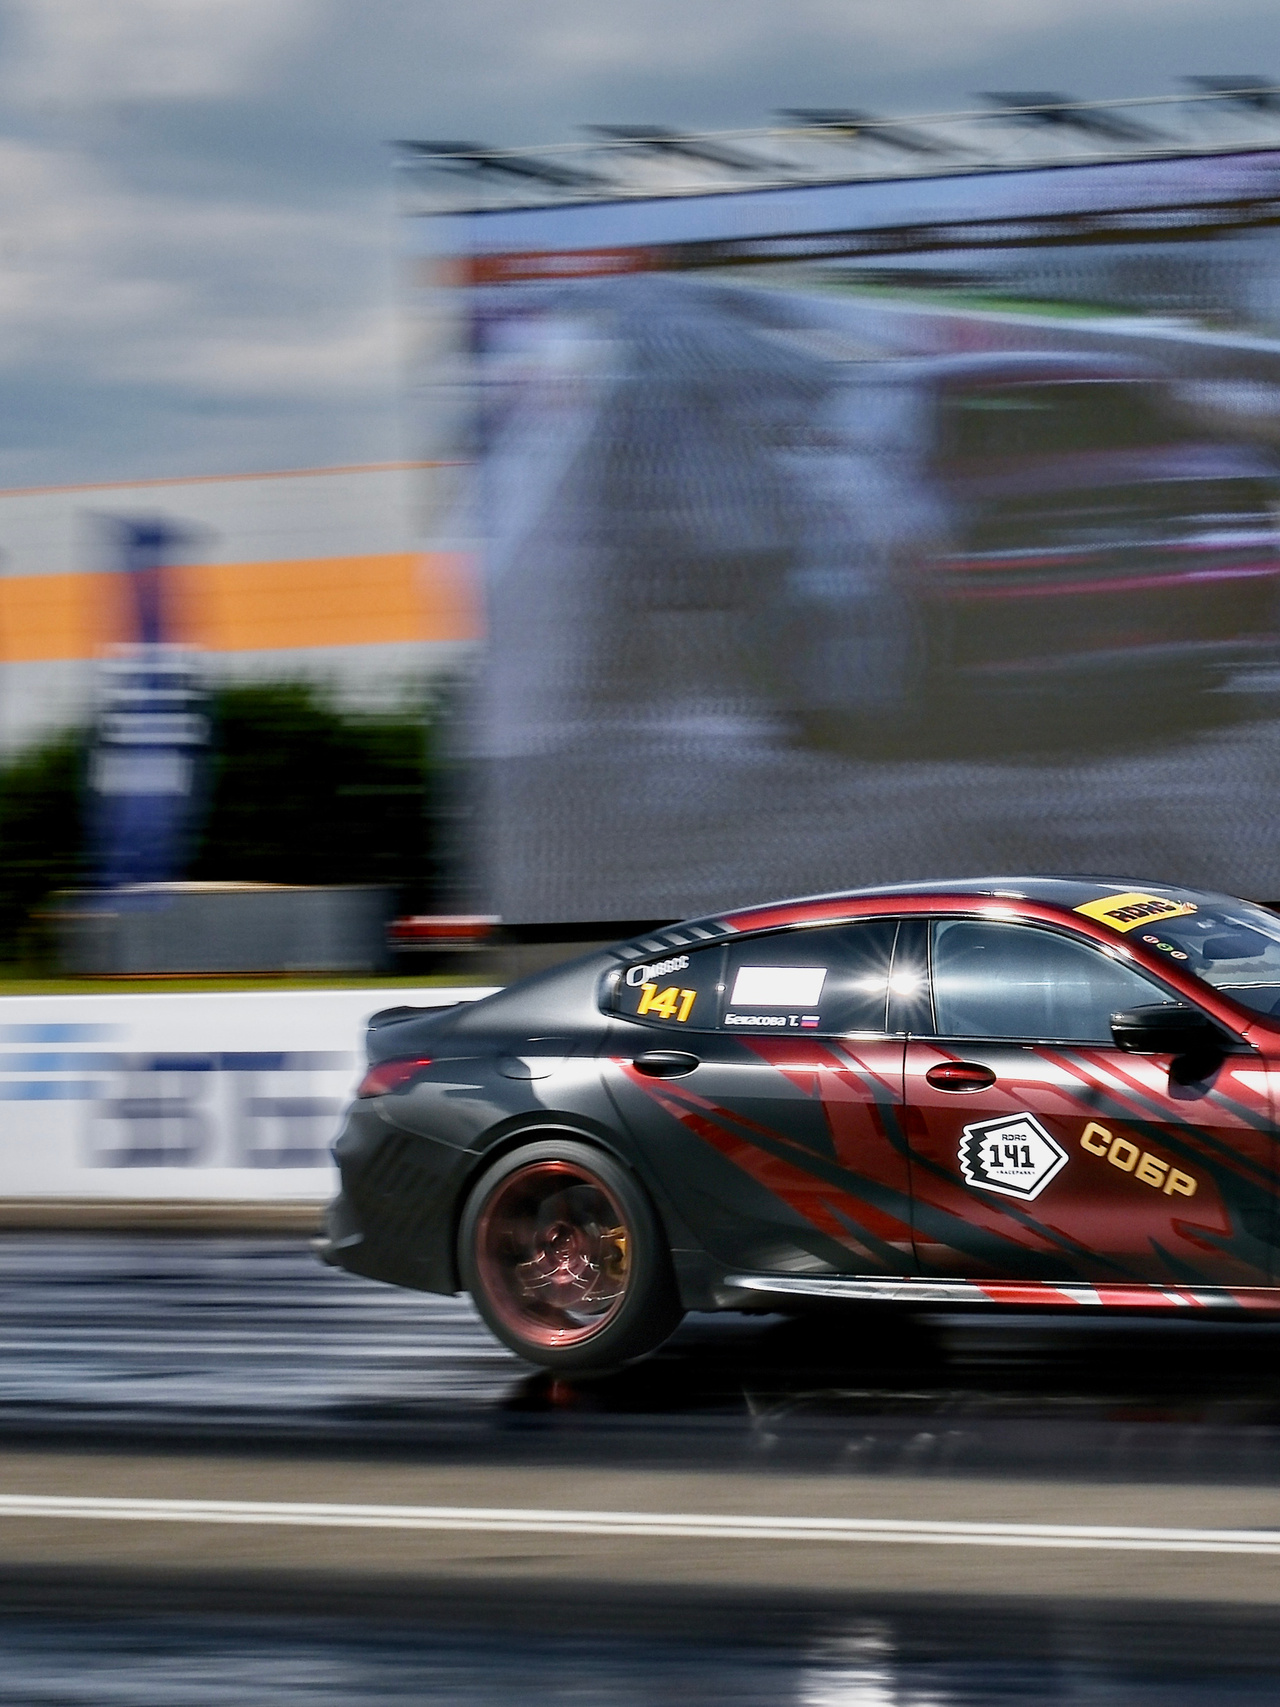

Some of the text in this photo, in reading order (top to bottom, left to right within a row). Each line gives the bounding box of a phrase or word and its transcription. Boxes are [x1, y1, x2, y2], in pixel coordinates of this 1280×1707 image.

[637, 982, 697, 1022] 141
[1001, 1133, 1027, 1142] RDRC
[989, 1144, 1035, 1168] 141
[1080, 1121, 1198, 1197] СОБР
